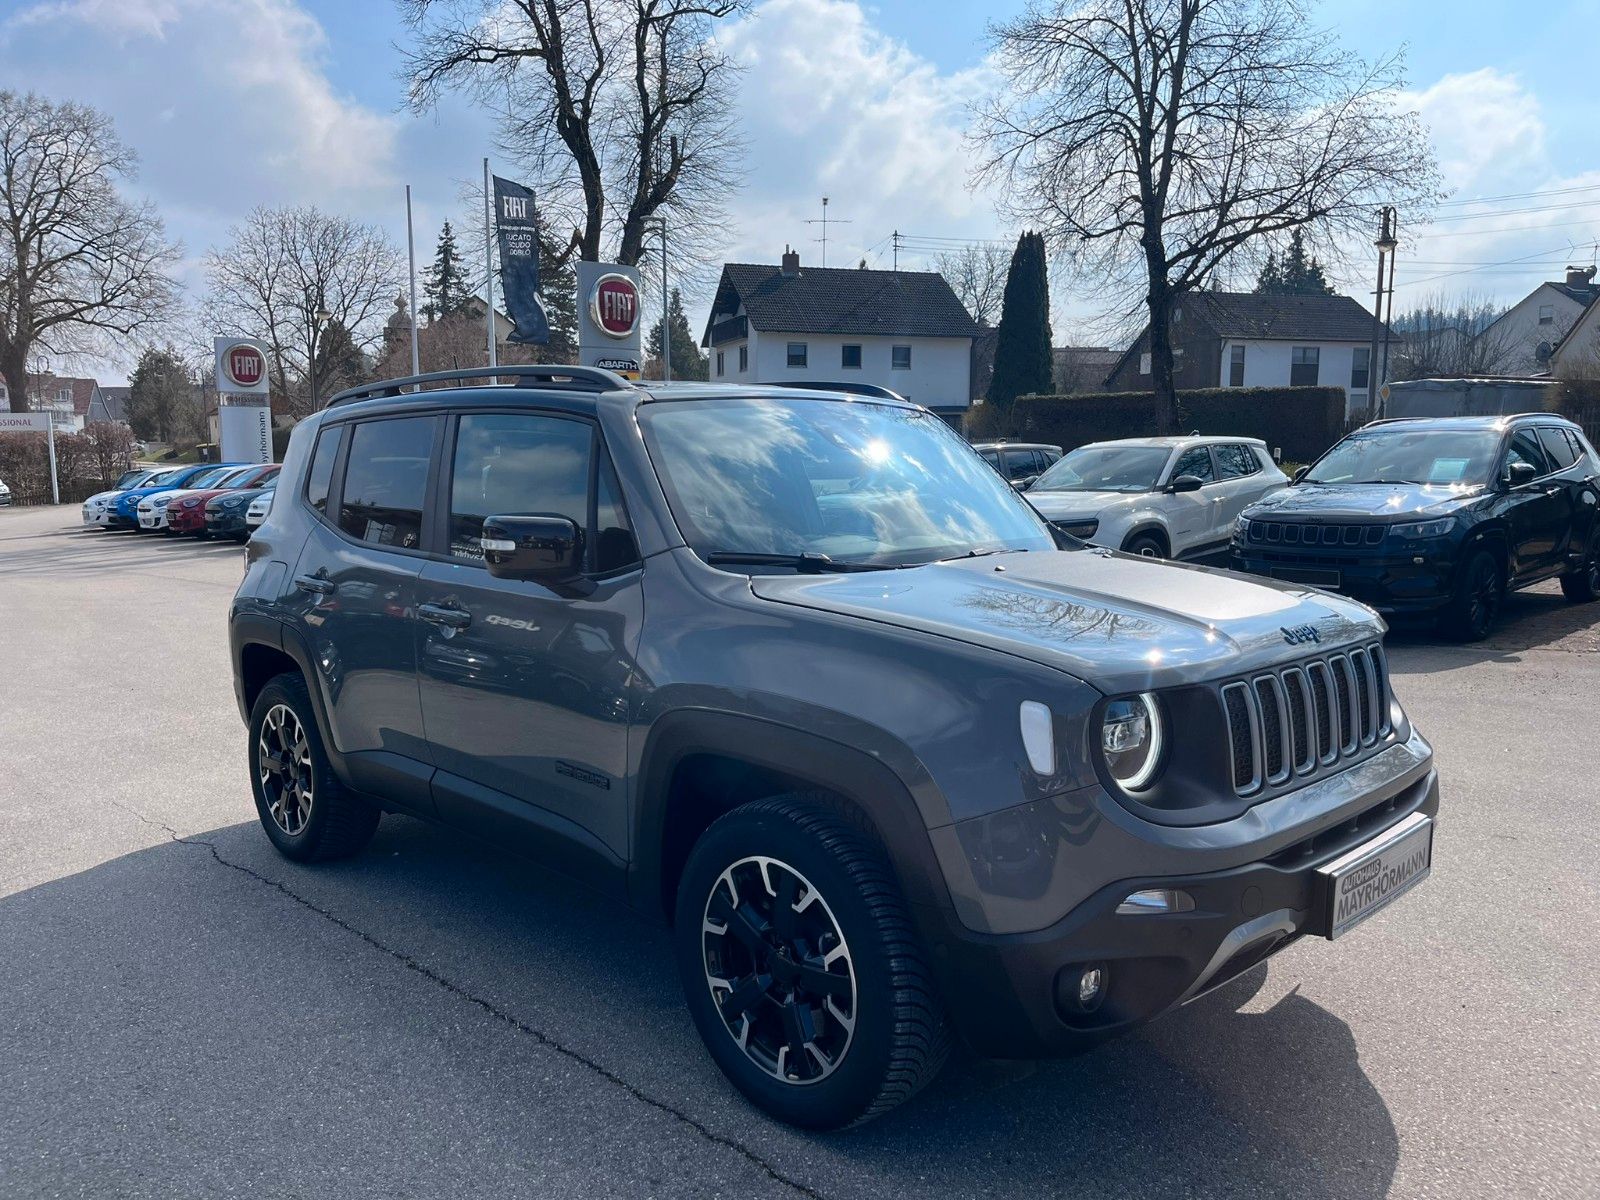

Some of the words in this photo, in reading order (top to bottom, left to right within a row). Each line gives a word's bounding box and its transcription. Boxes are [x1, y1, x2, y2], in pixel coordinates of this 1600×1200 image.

[503, 196, 527, 217] FIAT
[603, 291, 633, 322] FIAT
[234, 355, 259, 376] FIAT
[599, 360, 637, 369] ABARTH
[1280, 626, 1321, 646] Jeep
[1337, 848, 1426, 921] MAYRHÖRMANN
[1342, 860, 1380, 893] AUTOHAUS
